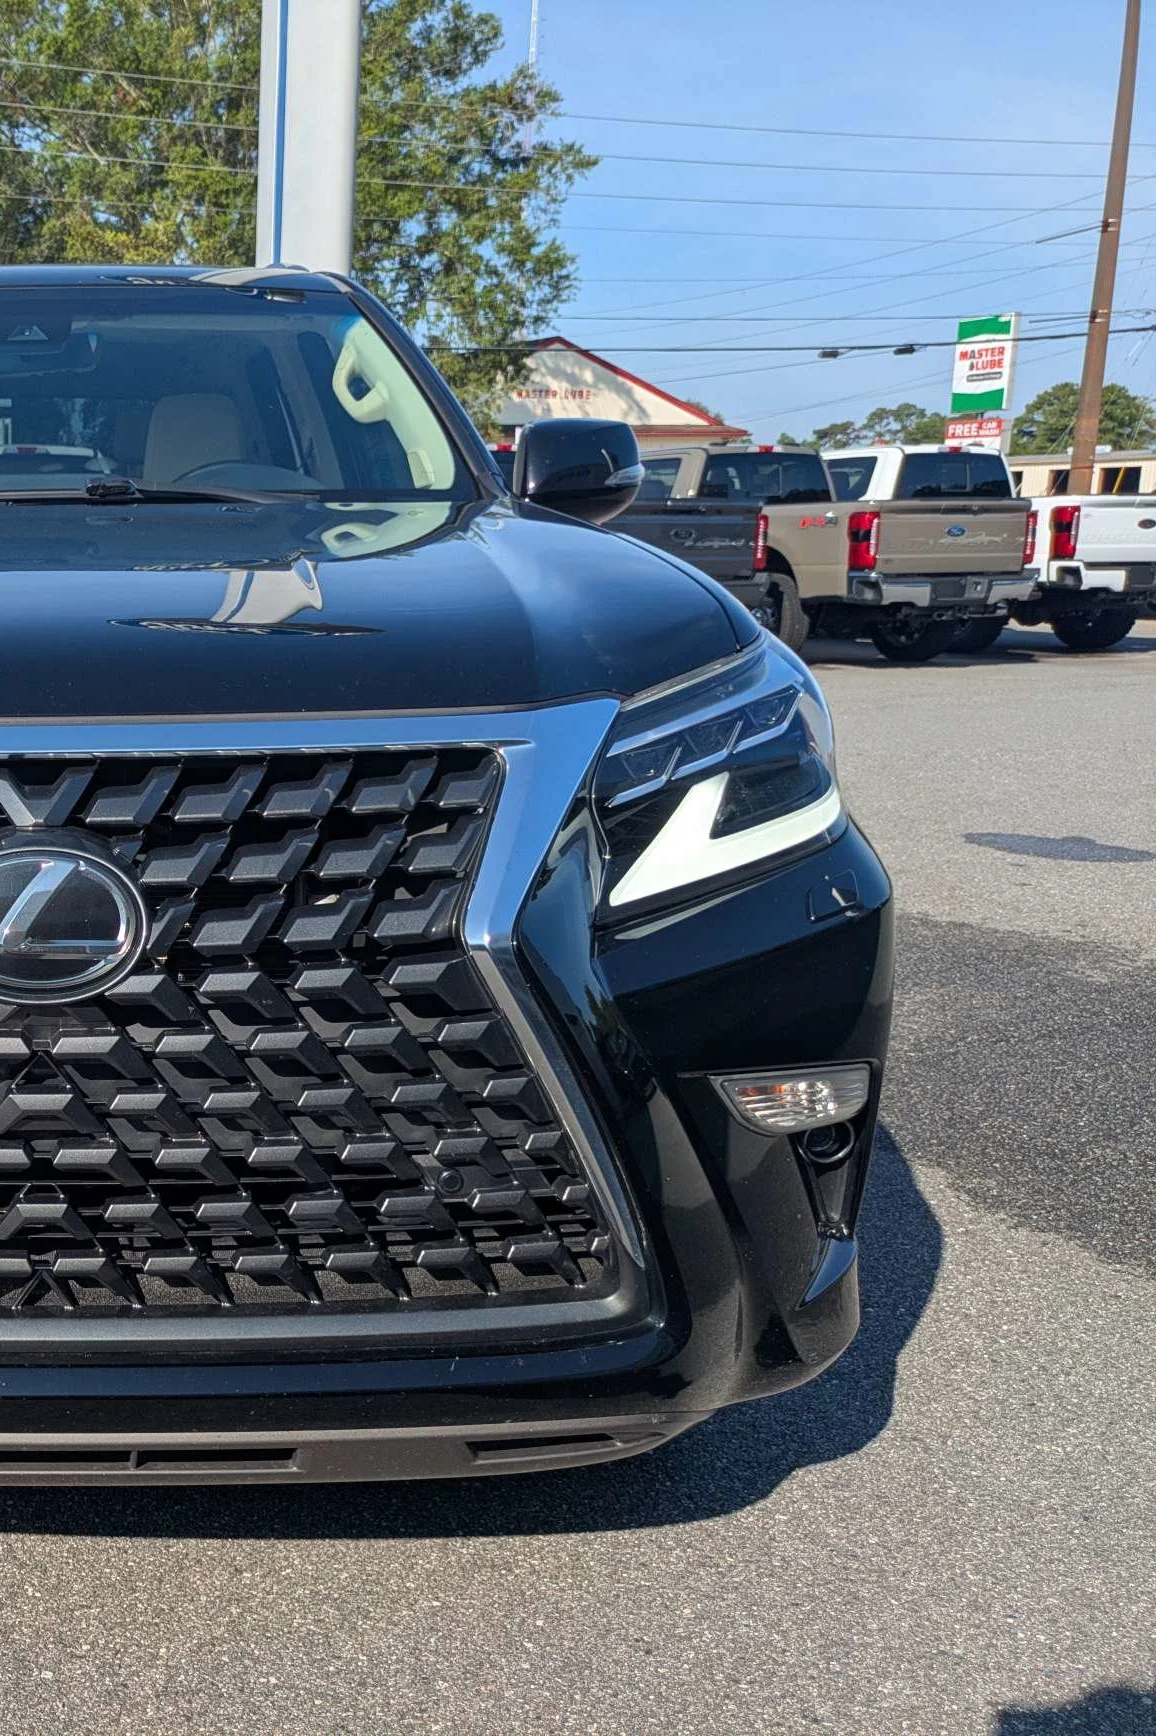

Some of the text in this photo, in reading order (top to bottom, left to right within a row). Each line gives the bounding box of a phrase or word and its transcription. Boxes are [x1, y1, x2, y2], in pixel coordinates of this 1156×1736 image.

[959, 346, 1005, 361] MASTER
[975, 358, 1004, 371] LUBE
[948, 424, 979, 437] FREE
